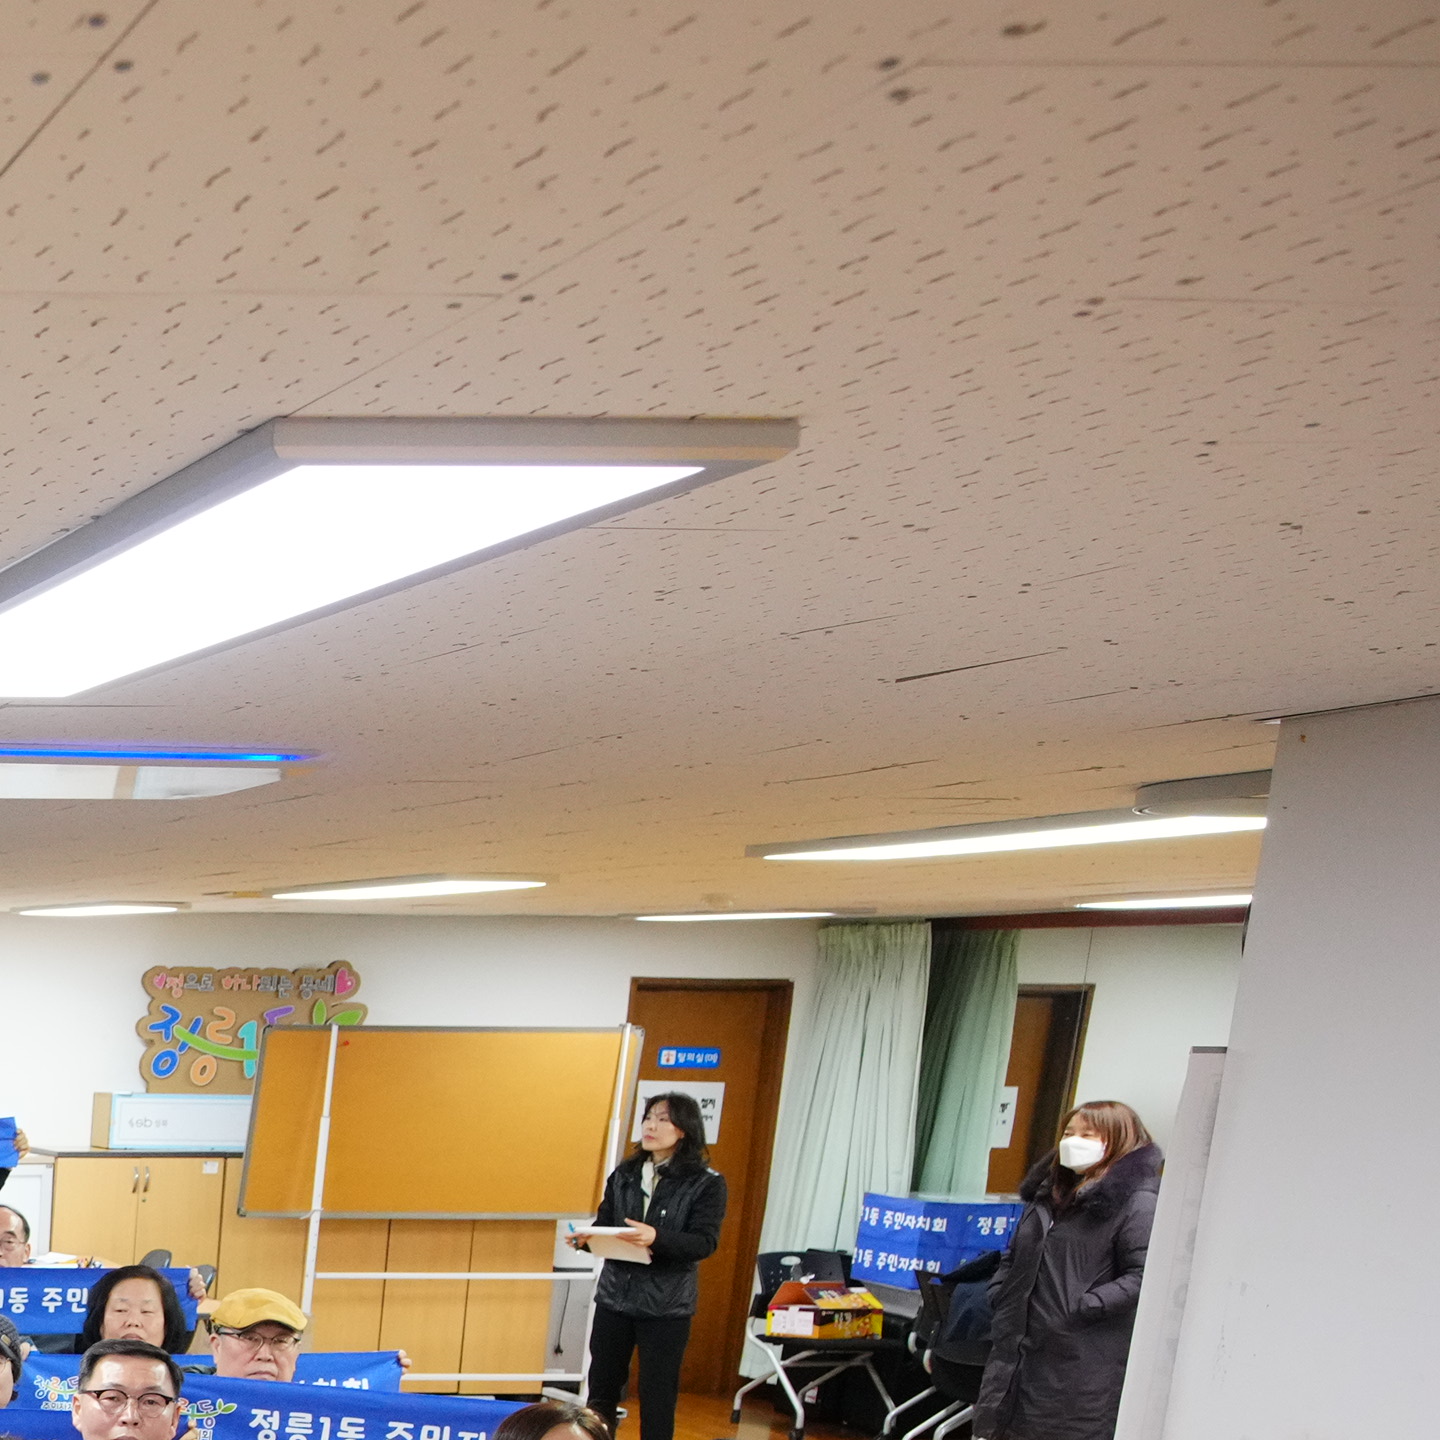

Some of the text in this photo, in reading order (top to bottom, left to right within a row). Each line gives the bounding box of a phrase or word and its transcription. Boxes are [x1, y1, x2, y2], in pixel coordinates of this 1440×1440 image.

[165, 973, 215, 999] 정으로
[221, 973, 293, 999] 하나되는
[883, 1210, 947, 1232] 주민자치회
